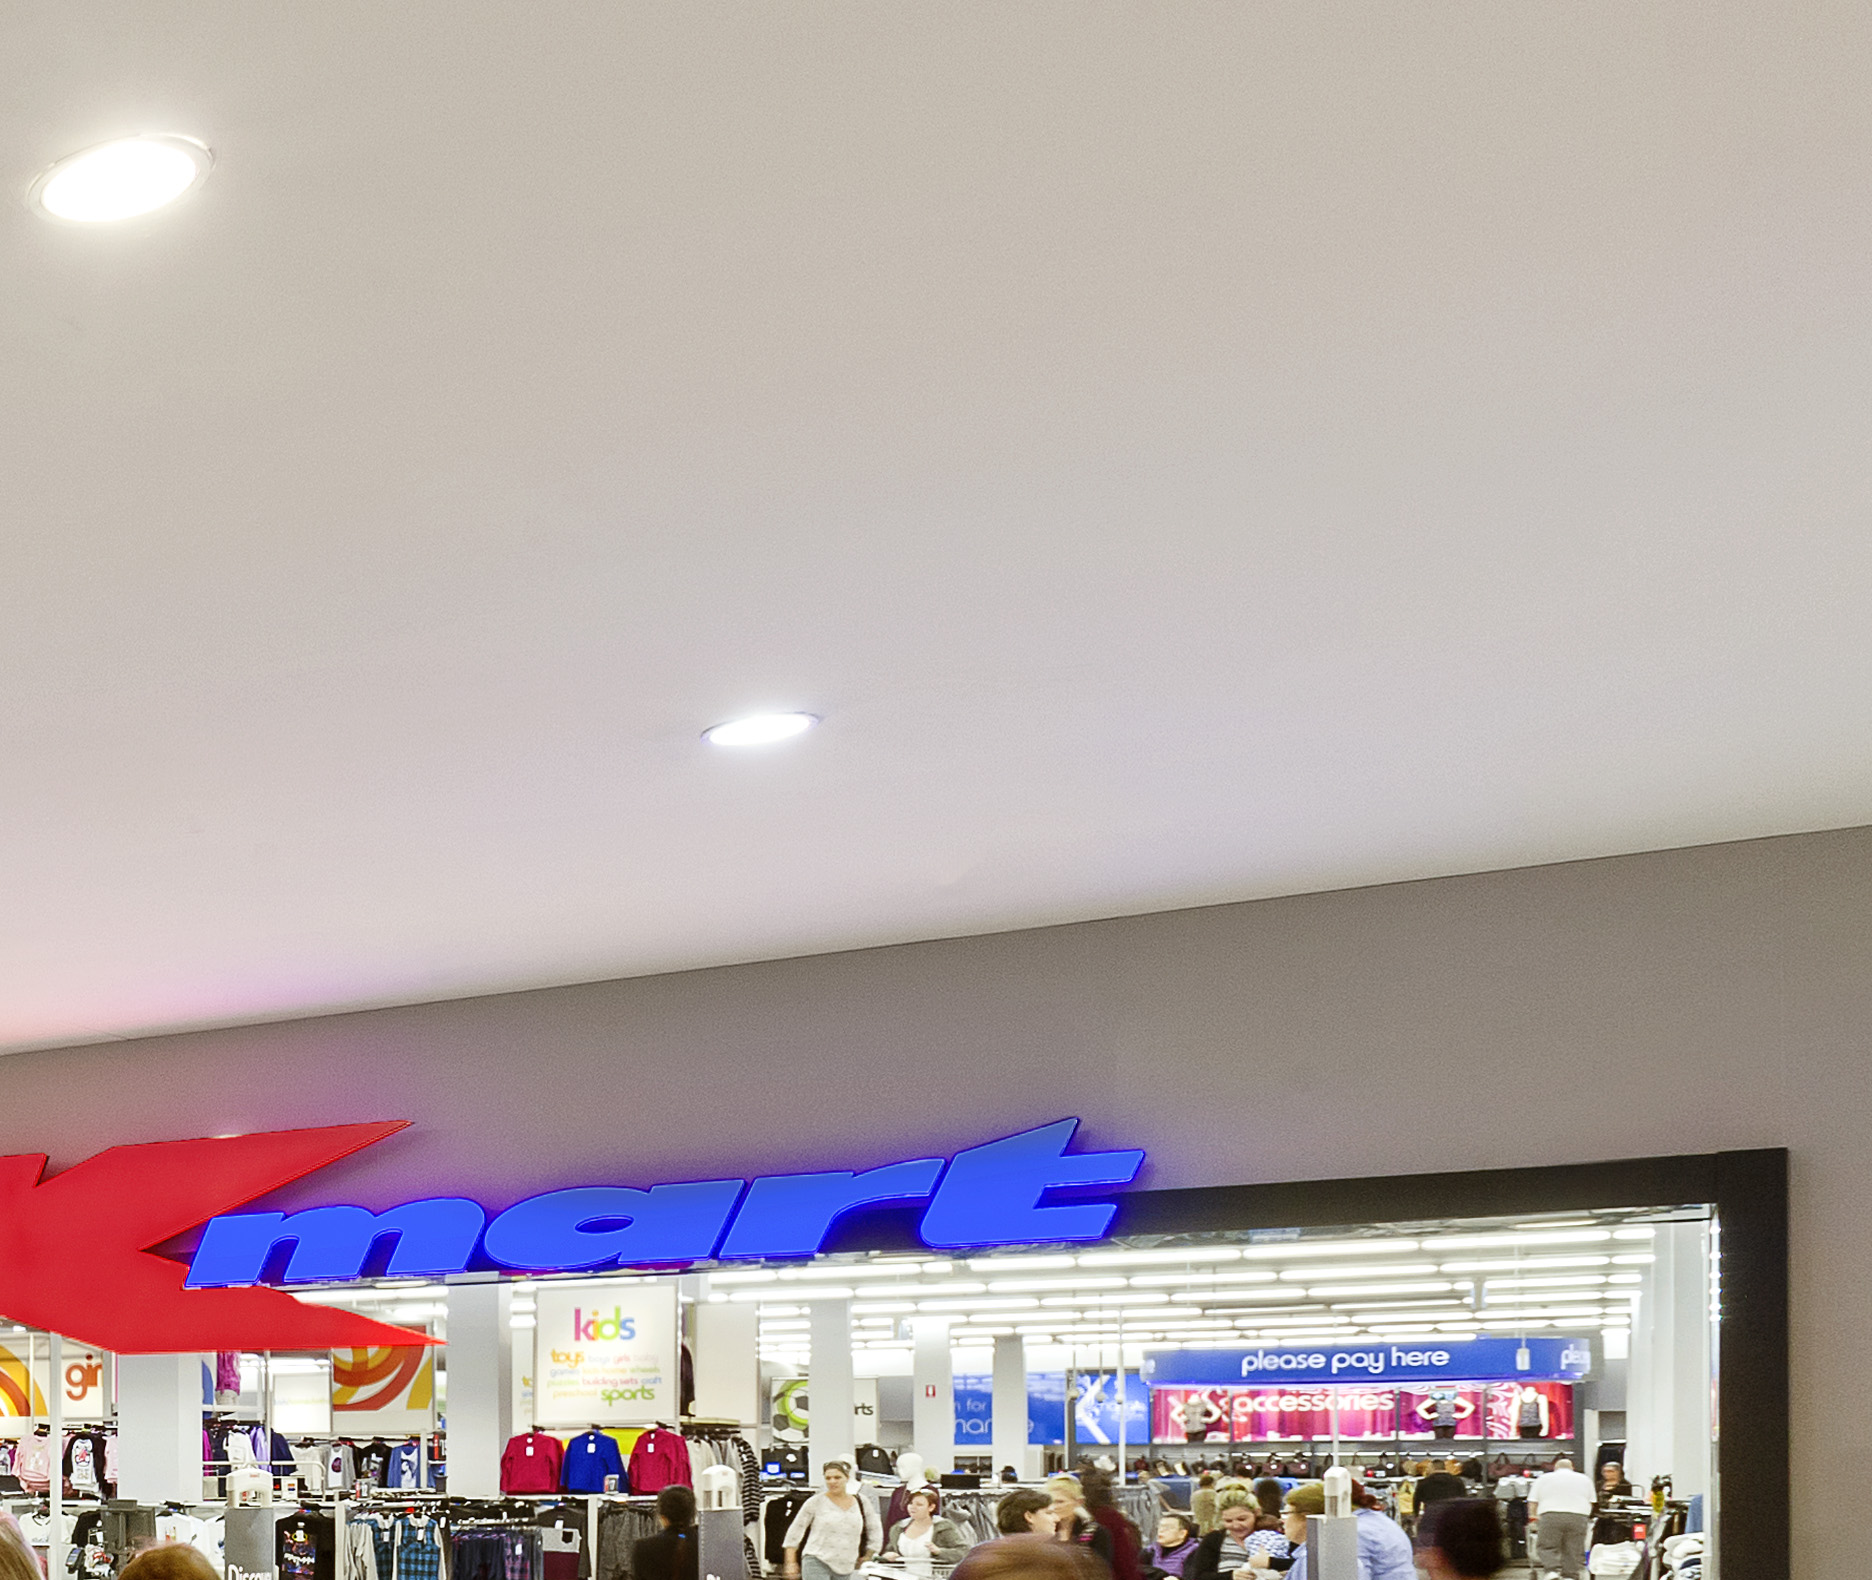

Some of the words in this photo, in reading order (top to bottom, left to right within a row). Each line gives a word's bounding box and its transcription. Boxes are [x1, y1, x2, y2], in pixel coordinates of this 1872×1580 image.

[574, 1306, 636, 1342] kids
[551, 1348, 585, 1368] toys
[1242, 1349, 1327, 1377] please
[1331, 1351, 1385, 1375] pay
[1391, 1346, 1450, 1367] here
[601, 1385, 655, 1407] sports
[1233, 1393, 1394, 1412] accessories
